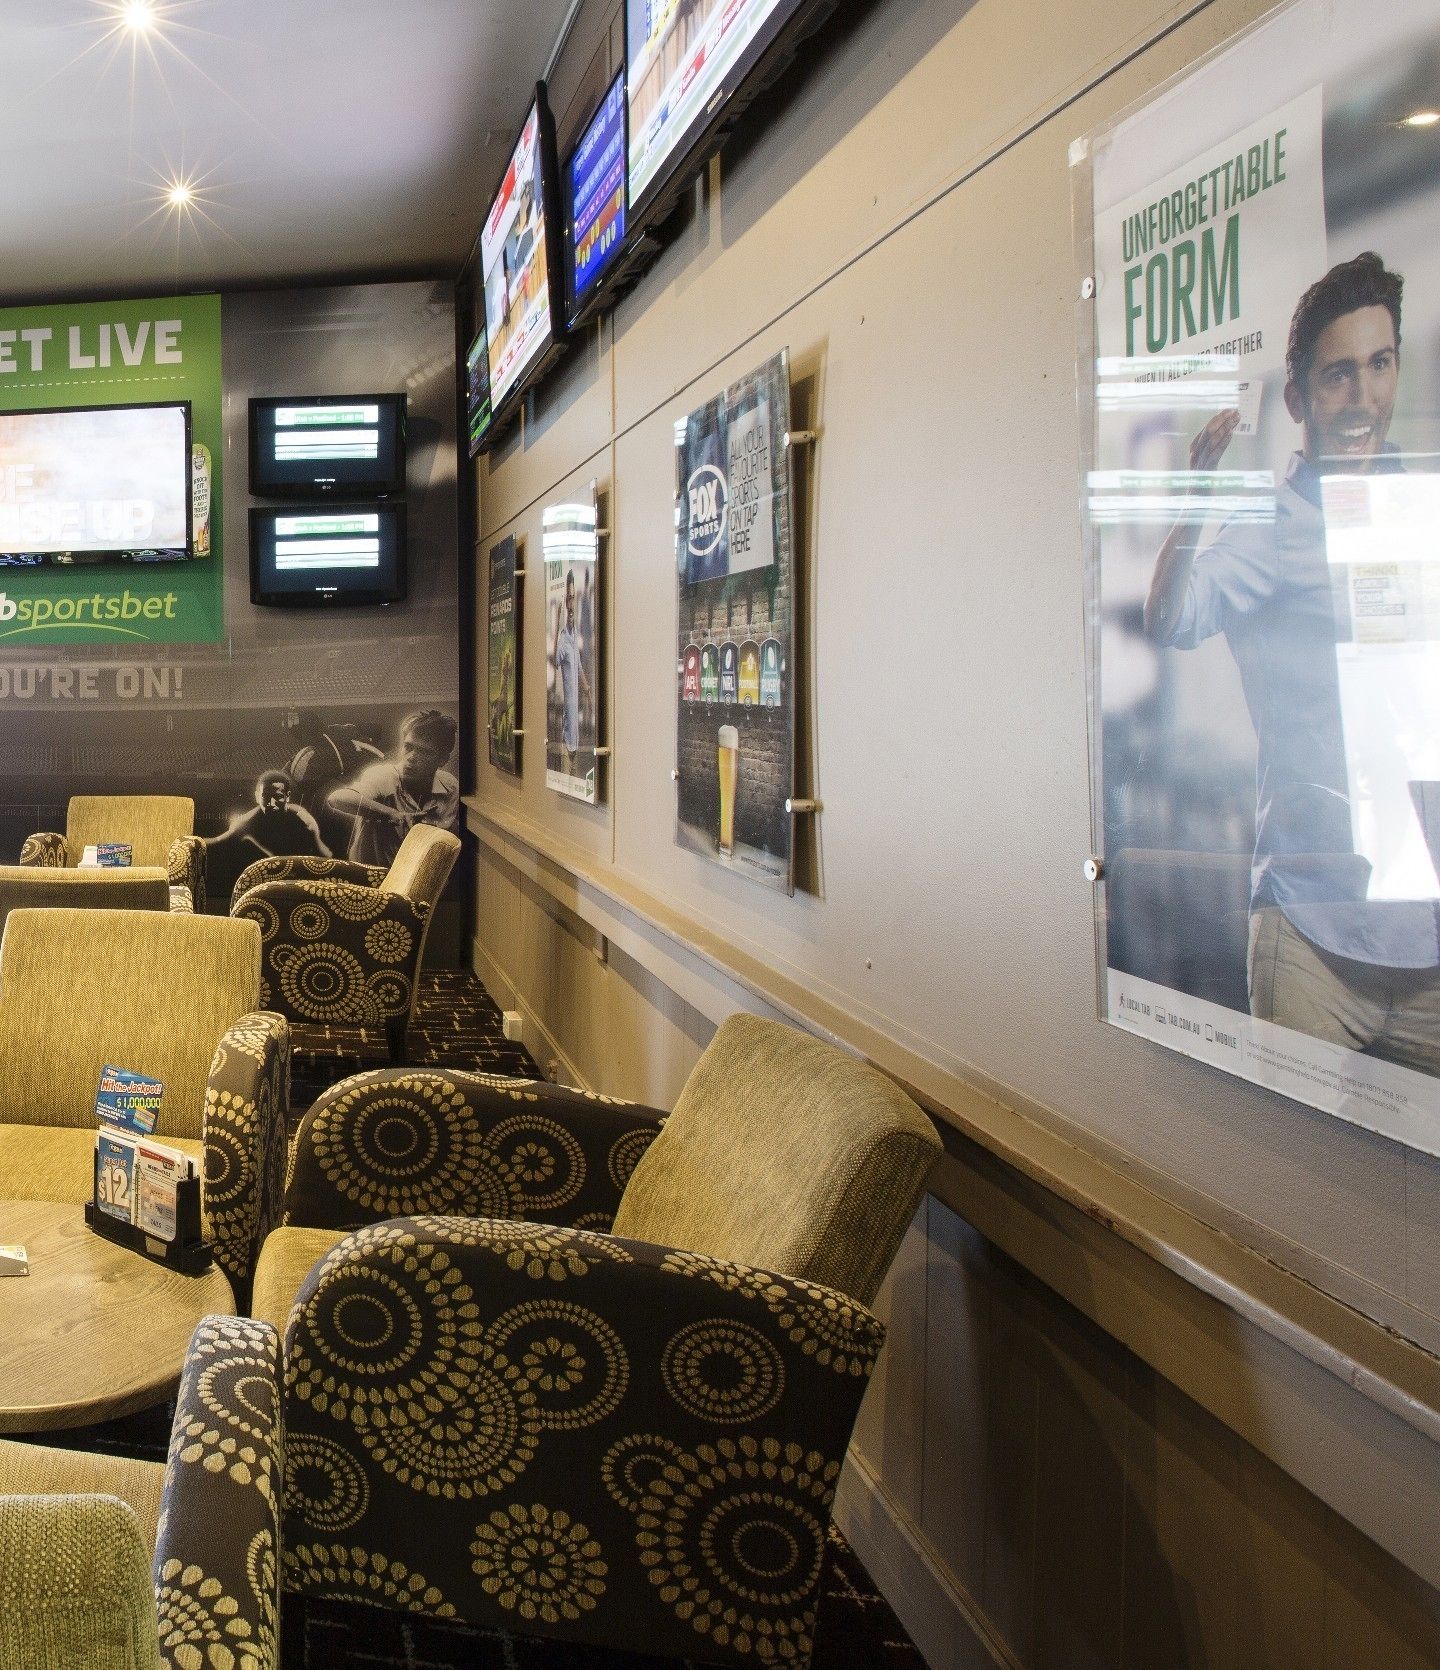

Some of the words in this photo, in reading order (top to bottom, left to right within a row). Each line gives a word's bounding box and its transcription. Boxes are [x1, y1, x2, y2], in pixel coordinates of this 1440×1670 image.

[1122, 128, 1287, 263] UNFORGETTABLE
[1124, 212, 1241, 358] FORM
[69, 320, 182, 369] LIVE
[1214, 331, 1263, 357] TOGETHER
[731, 441, 743, 461] ALL
[743, 425, 765, 454] YOUR
[731, 446, 768, 482] FAVOURITE
[689, 479, 718, 524] FOX
[732, 477, 760, 508] SPORTS
[689, 520, 720, 541] SPORTS
[731, 509, 742, 532] ON
[743, 502, 759, 528] TAP
[730, 529, 751, 556] HERE
[115, 667, 183, 699] ON!
[100, 1077, 116, 1093] Hit
[115, 1081, 127, 1093] the
[126, 1080, 163, 1096] Jackpot!
[116, 1096, 161, 1110] $1,000,000
[98, 1164, 131, 1208] $12
